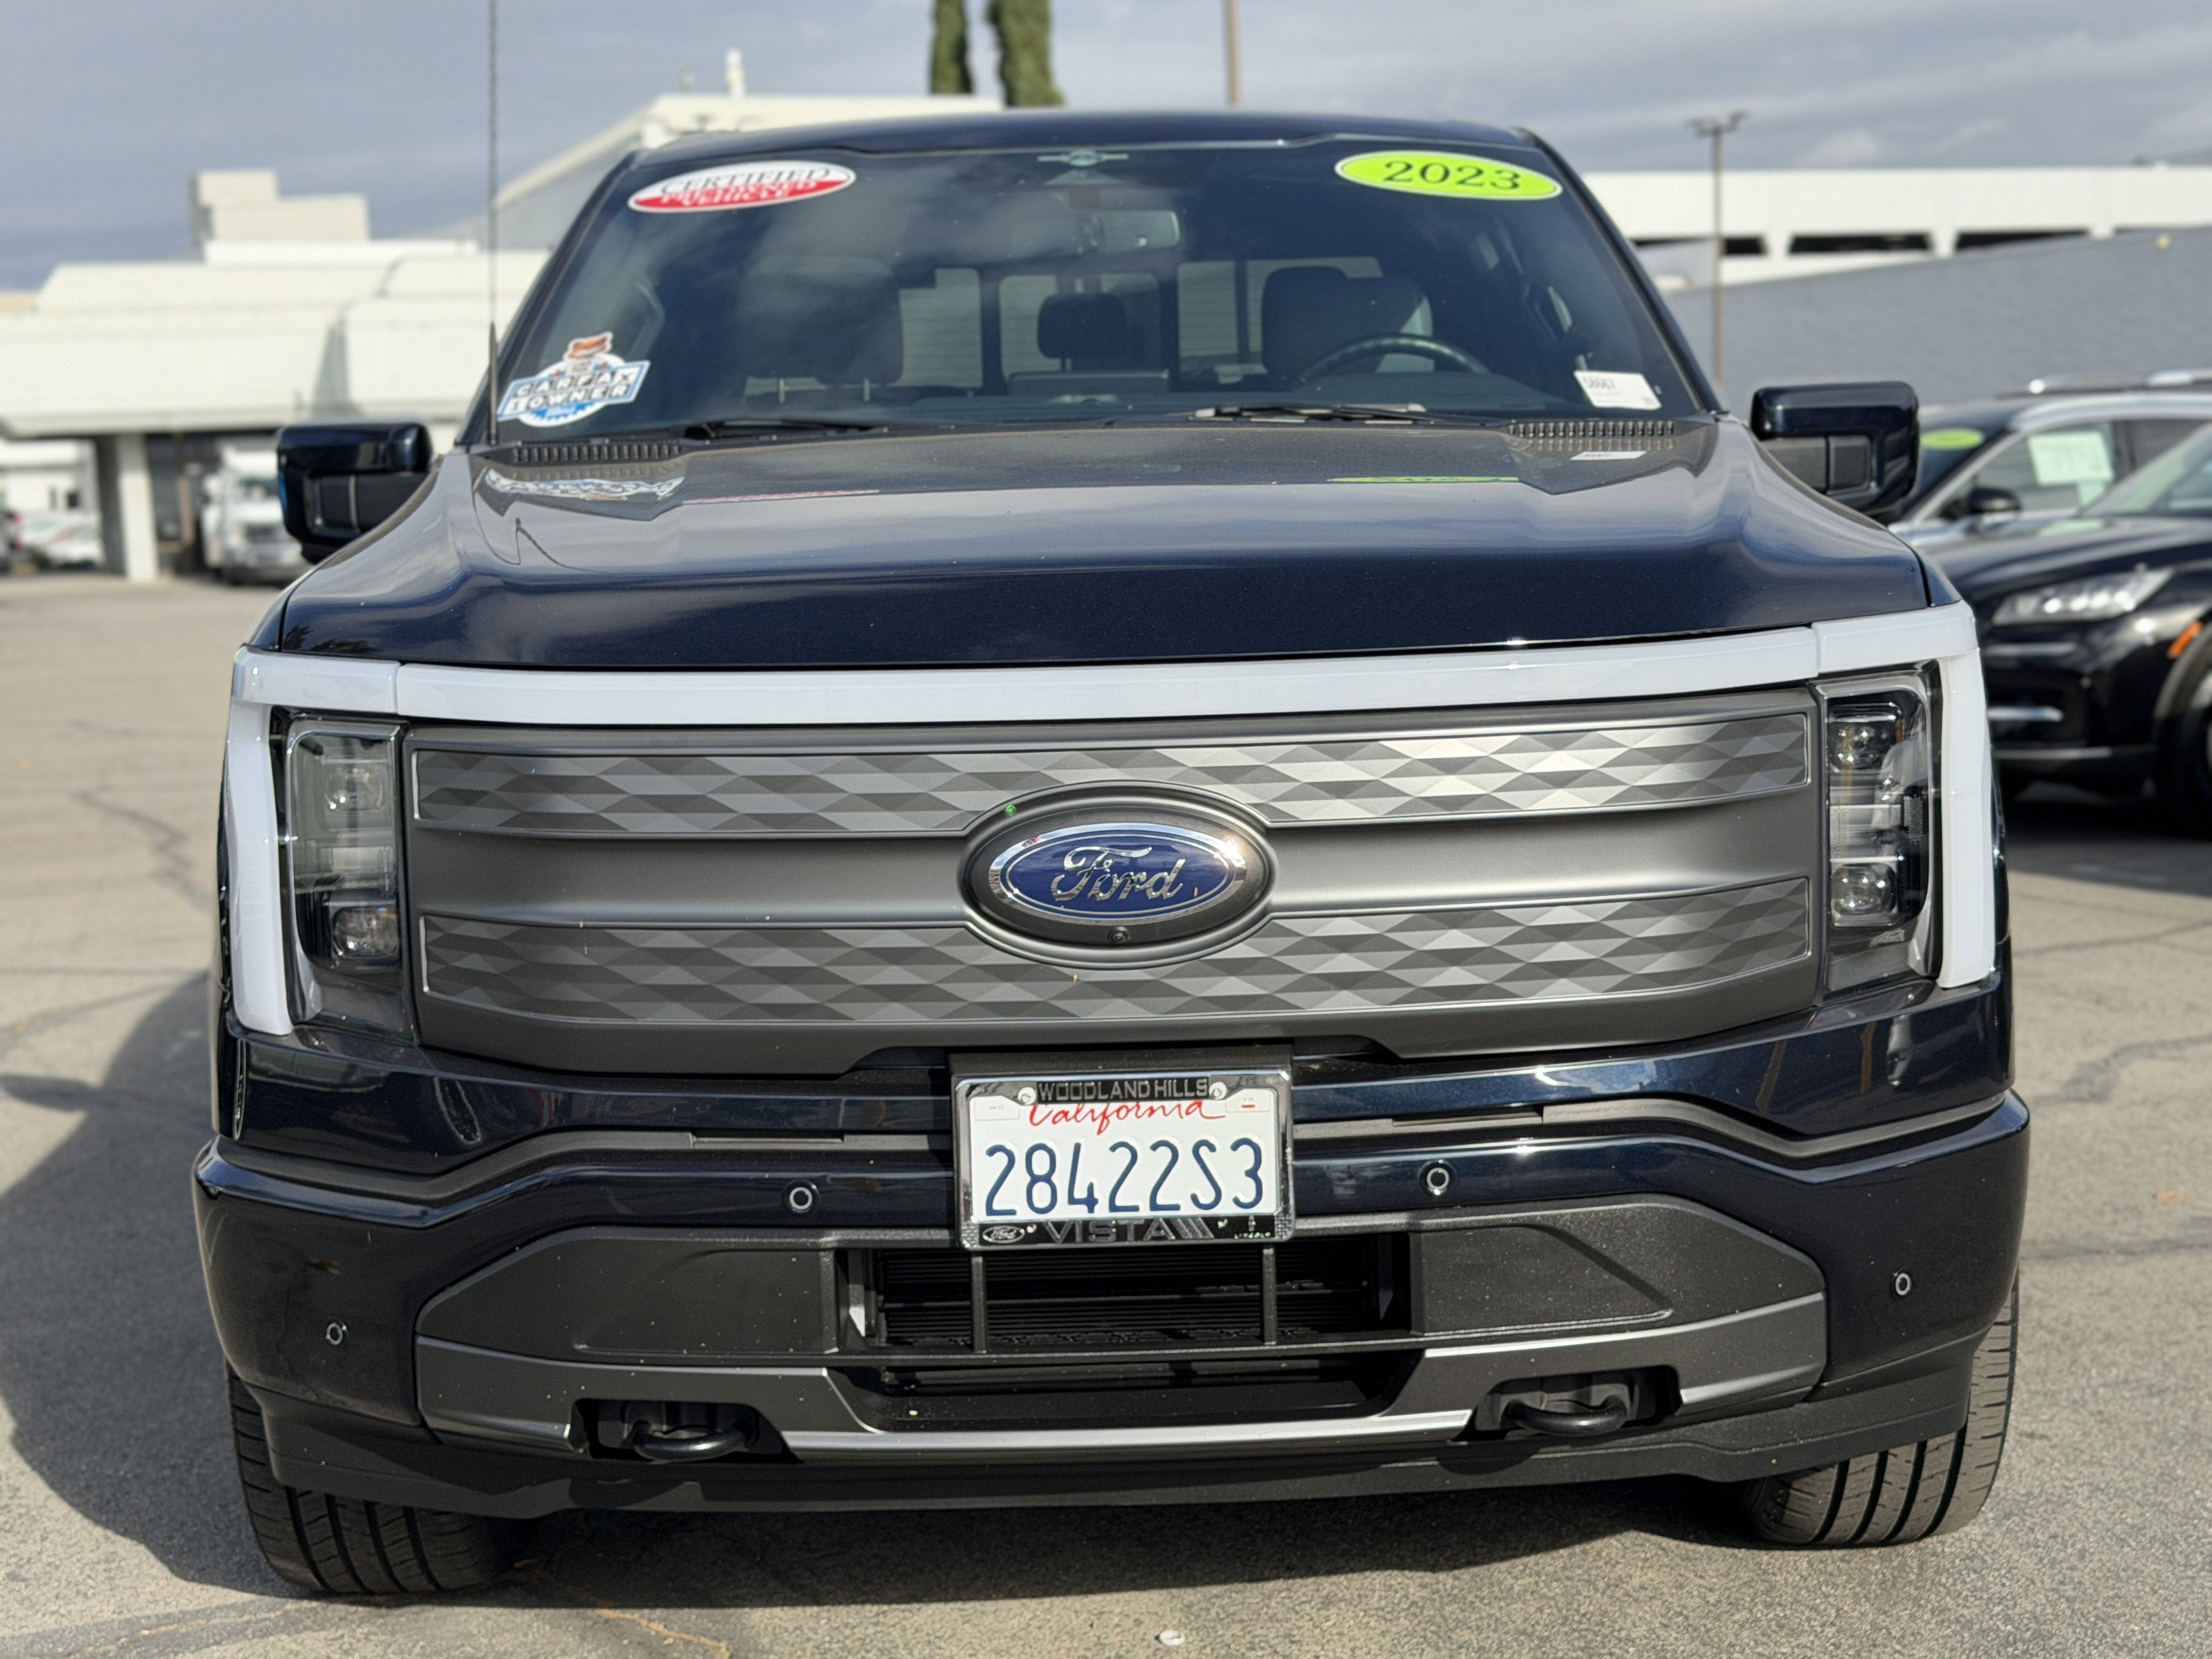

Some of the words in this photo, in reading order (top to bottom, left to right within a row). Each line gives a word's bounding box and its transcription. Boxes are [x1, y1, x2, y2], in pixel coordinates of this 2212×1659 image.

[661, 168, 830, 194] CERTIFIED
[1383, 160, 1521, 190] 2023
[516, 371, 634, 396] CARFAX
[529, 385, 627, 408] OWNER
[1051, 845, 1186, 902] Ford
[1039, 1081, 1150, 1101] WOODLAND
[1154, 1076, 1207, 1098] HILLS
[1029, 1099, 1226, 1136] California
[985, 1137, 1262, 1216] 28422S3
[1043, 1218, 1176, 1244] VISTA
